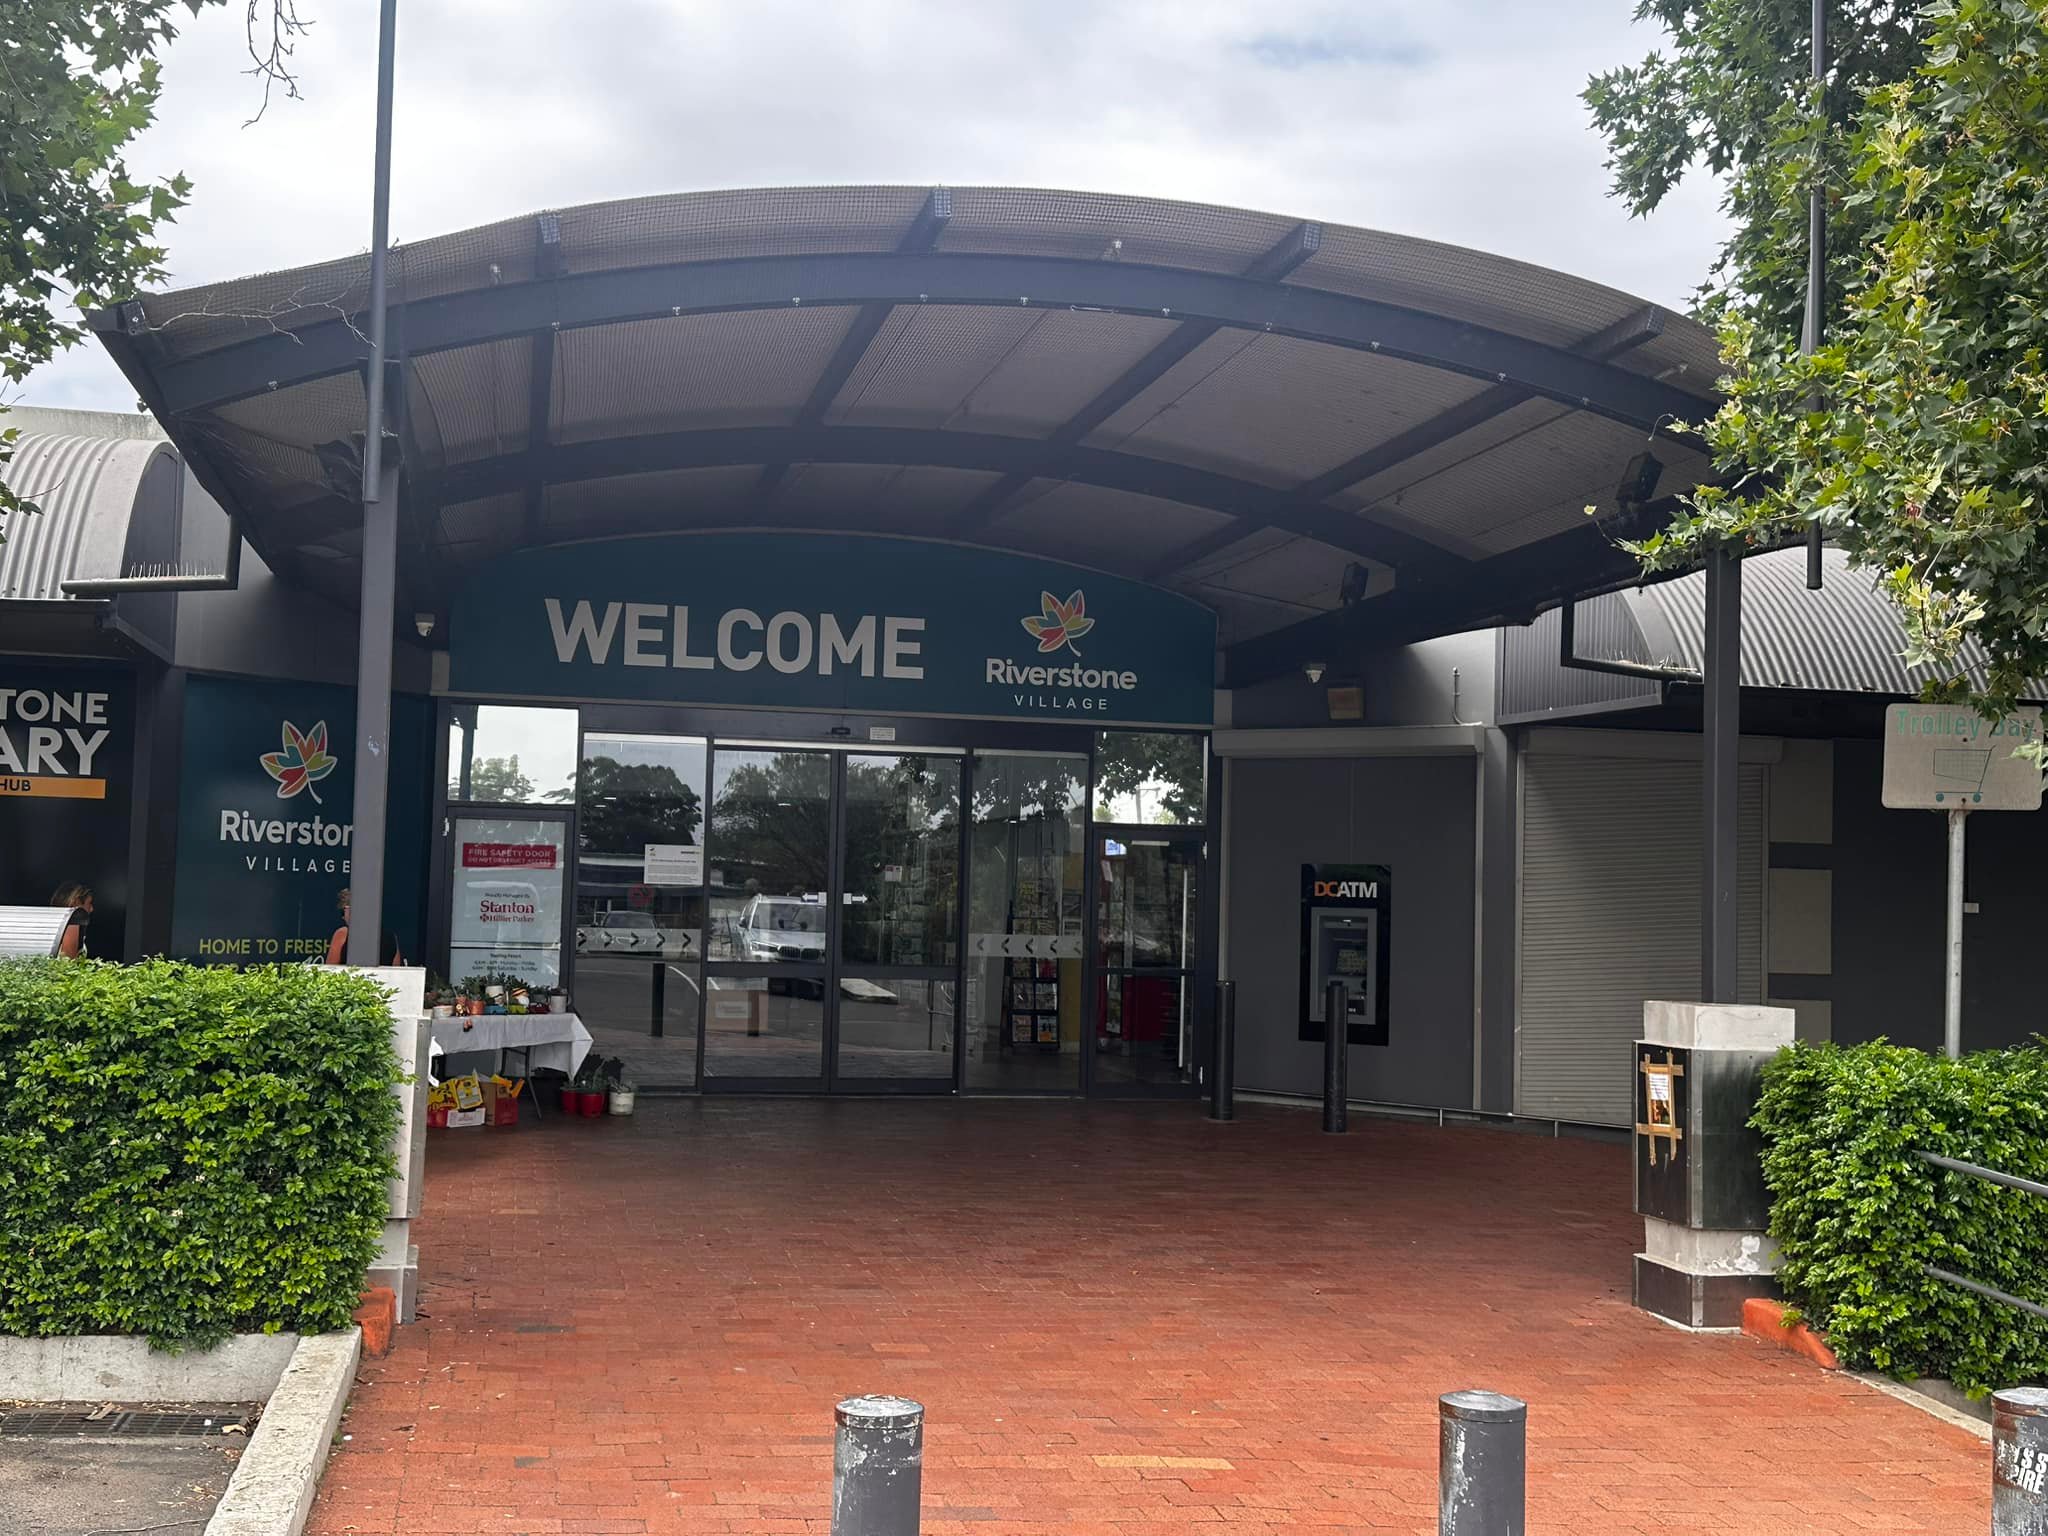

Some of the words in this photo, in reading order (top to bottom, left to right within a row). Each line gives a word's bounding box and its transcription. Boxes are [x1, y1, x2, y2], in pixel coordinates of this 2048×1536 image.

[544, 598, 926, 680] WELCOME
[985, 657, 1138, 690] Riverstone
[1014, 694, 1108, 710] VILLAGE
[1896, 709, 1981, 741] Trolley
[0, 778, 31, 792] HUB
[220, 809, 354, 847] Riverston
[490, 848, 522, 857] SAFETY
[246, 856, 351, 873] VILLAGE
[1314, 881, 1378, 898] DCATM
[480, 899, 535, 914] Stanton
[199, 938, 250, 954] HOME
[256, 938, 279, 955] TO
[284, 938, 332, 954] FRESH
